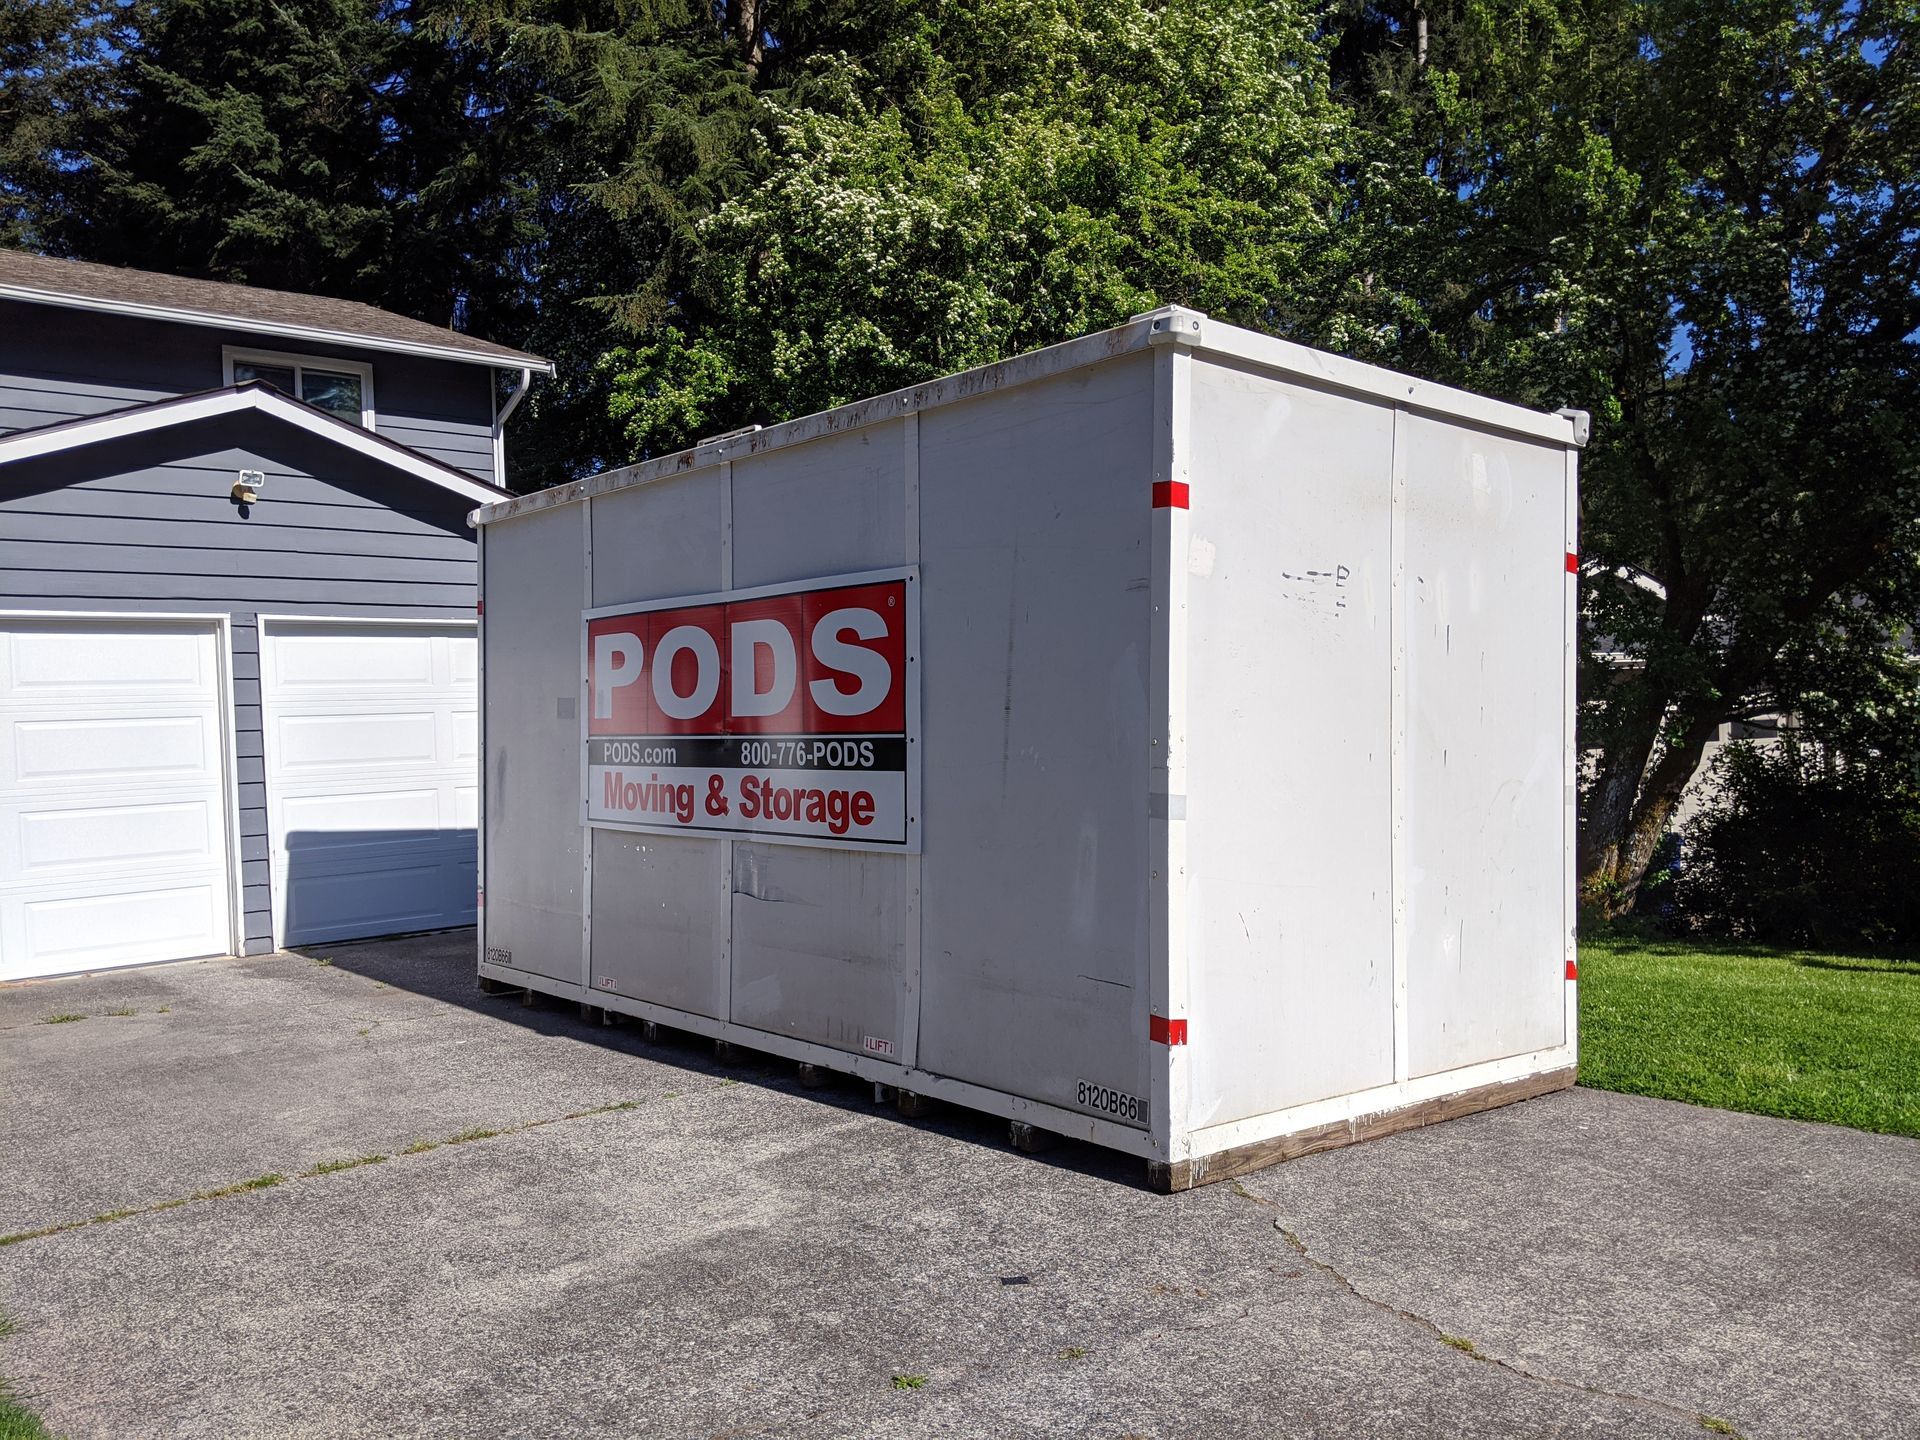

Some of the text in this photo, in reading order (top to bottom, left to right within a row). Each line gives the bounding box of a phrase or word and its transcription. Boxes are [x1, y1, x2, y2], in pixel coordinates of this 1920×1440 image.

[594, 607, 892, 720] PODS
[603, 742, 677, 764] PODS.com
[741, 741, 875, 767] 800-776-PODS
[603, 772, 876, 834] Moving & Storage
[869, 1039, 888, 1054] LIFT
[1077, 1081, 1138, 1121] 8120B66
